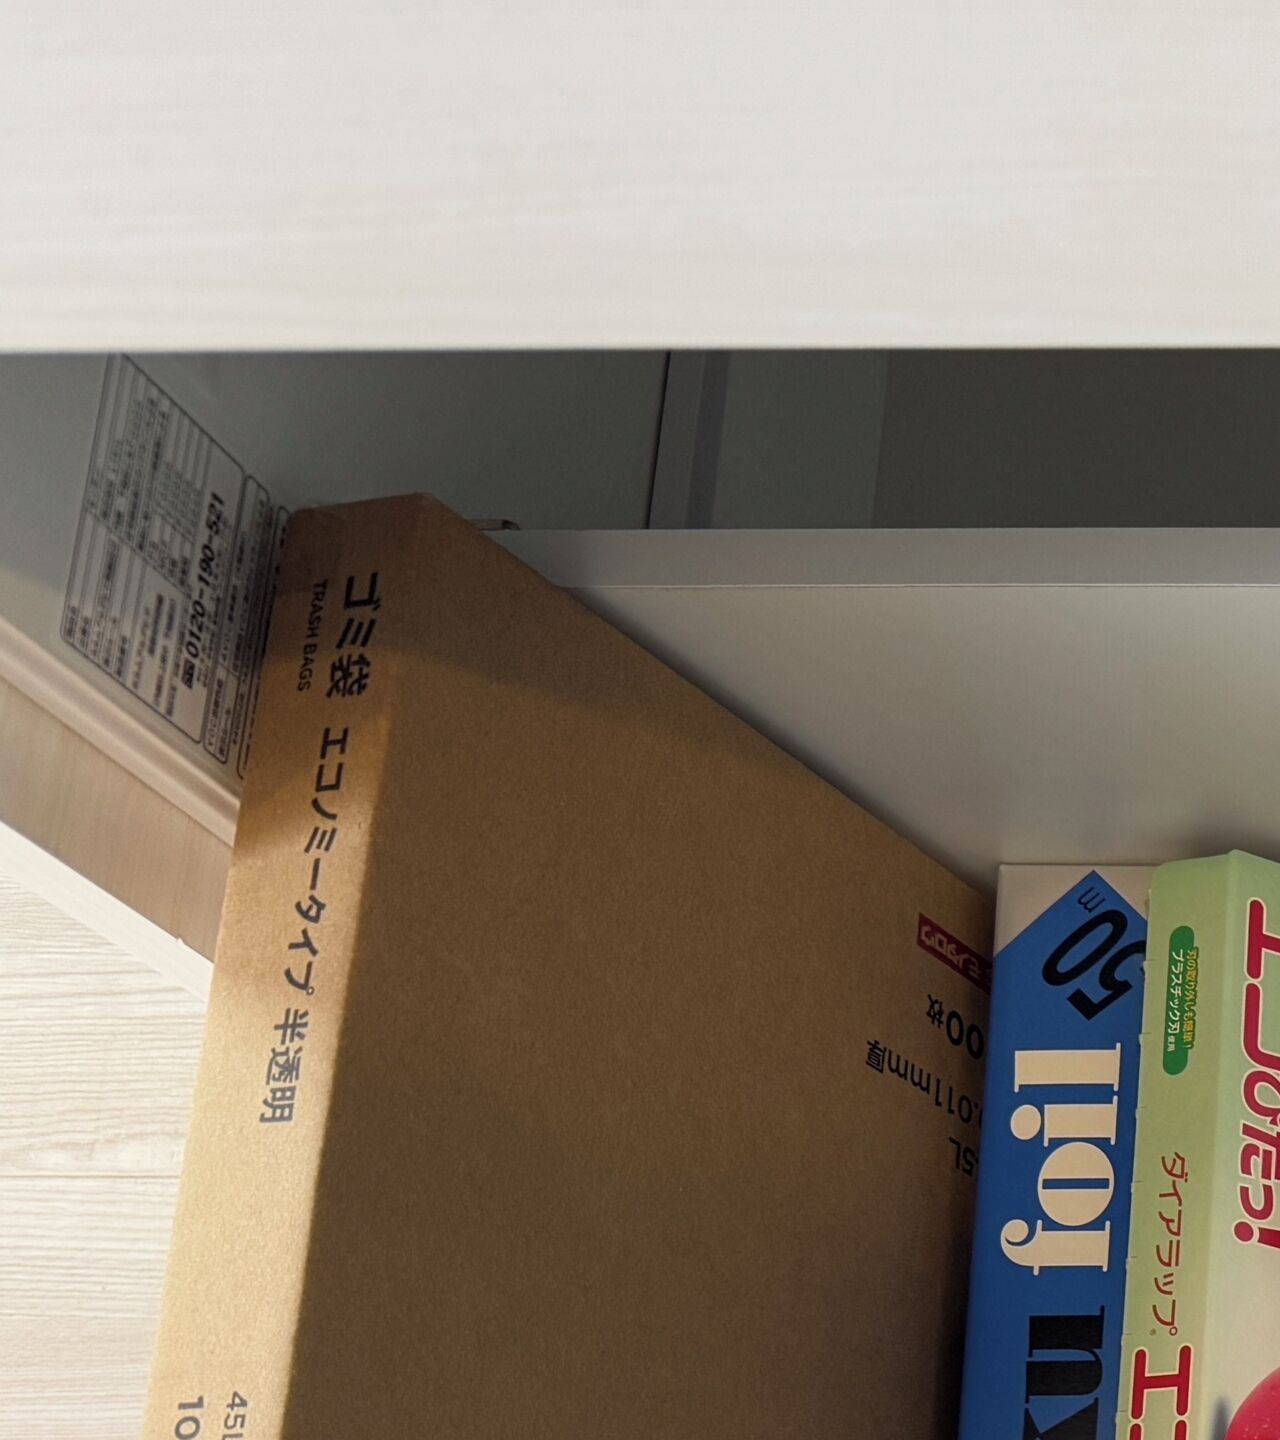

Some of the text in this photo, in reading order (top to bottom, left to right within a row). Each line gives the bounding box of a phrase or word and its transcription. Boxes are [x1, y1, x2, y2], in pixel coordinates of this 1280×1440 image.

[185, 492, 225, 658] 0120-190-521
[296, 578, 329, 692] TRASH BAGS
[258, 571, 381, 1124] ゴミ袋 エコノミータイプ 半透明
[926, 993, 985, 1061] 00枚
[948, 1136, 981, 1177] 5L
[1000, 1042, 1121, 1276] foil
[1151, 1151, 1186, 1337] ダイアラップ
